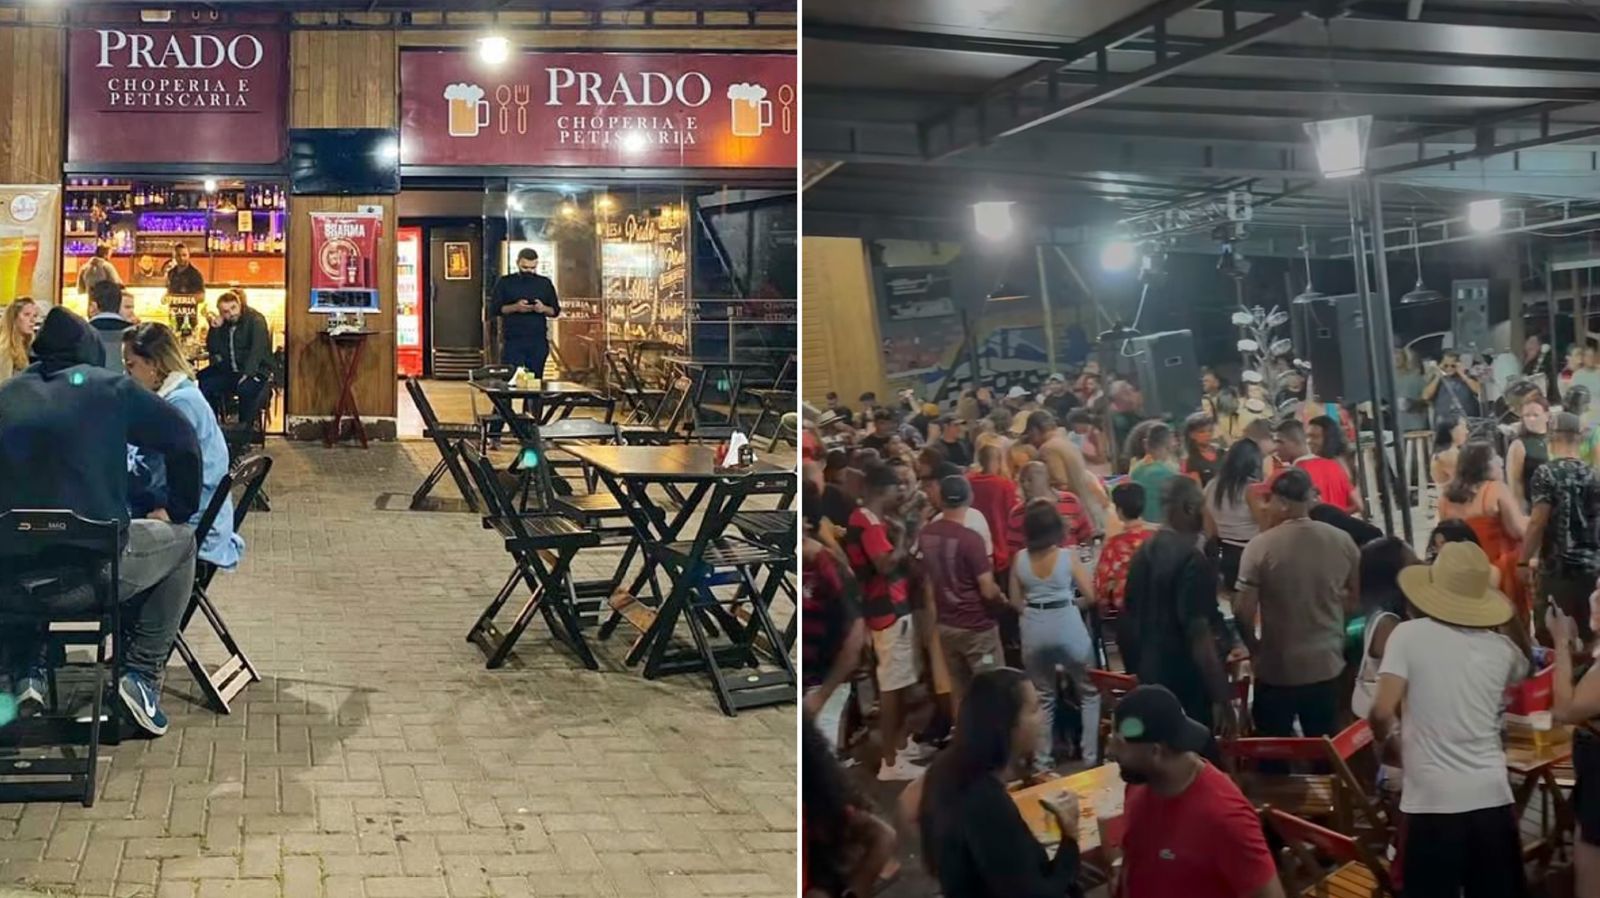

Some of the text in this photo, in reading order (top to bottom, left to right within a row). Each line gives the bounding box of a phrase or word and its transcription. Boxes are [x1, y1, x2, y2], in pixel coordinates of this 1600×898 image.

[96, 29, 264, 69] PRADO
[107, 78, 250, 92] CHOPERIA E
[544, 67, 712, 107] PRADO
[110, 92, 248, 107] PETISCARIA
[557, 115, 698, 130] CHOPERIA E
[559, 131, 696, 145] PETISARIA
